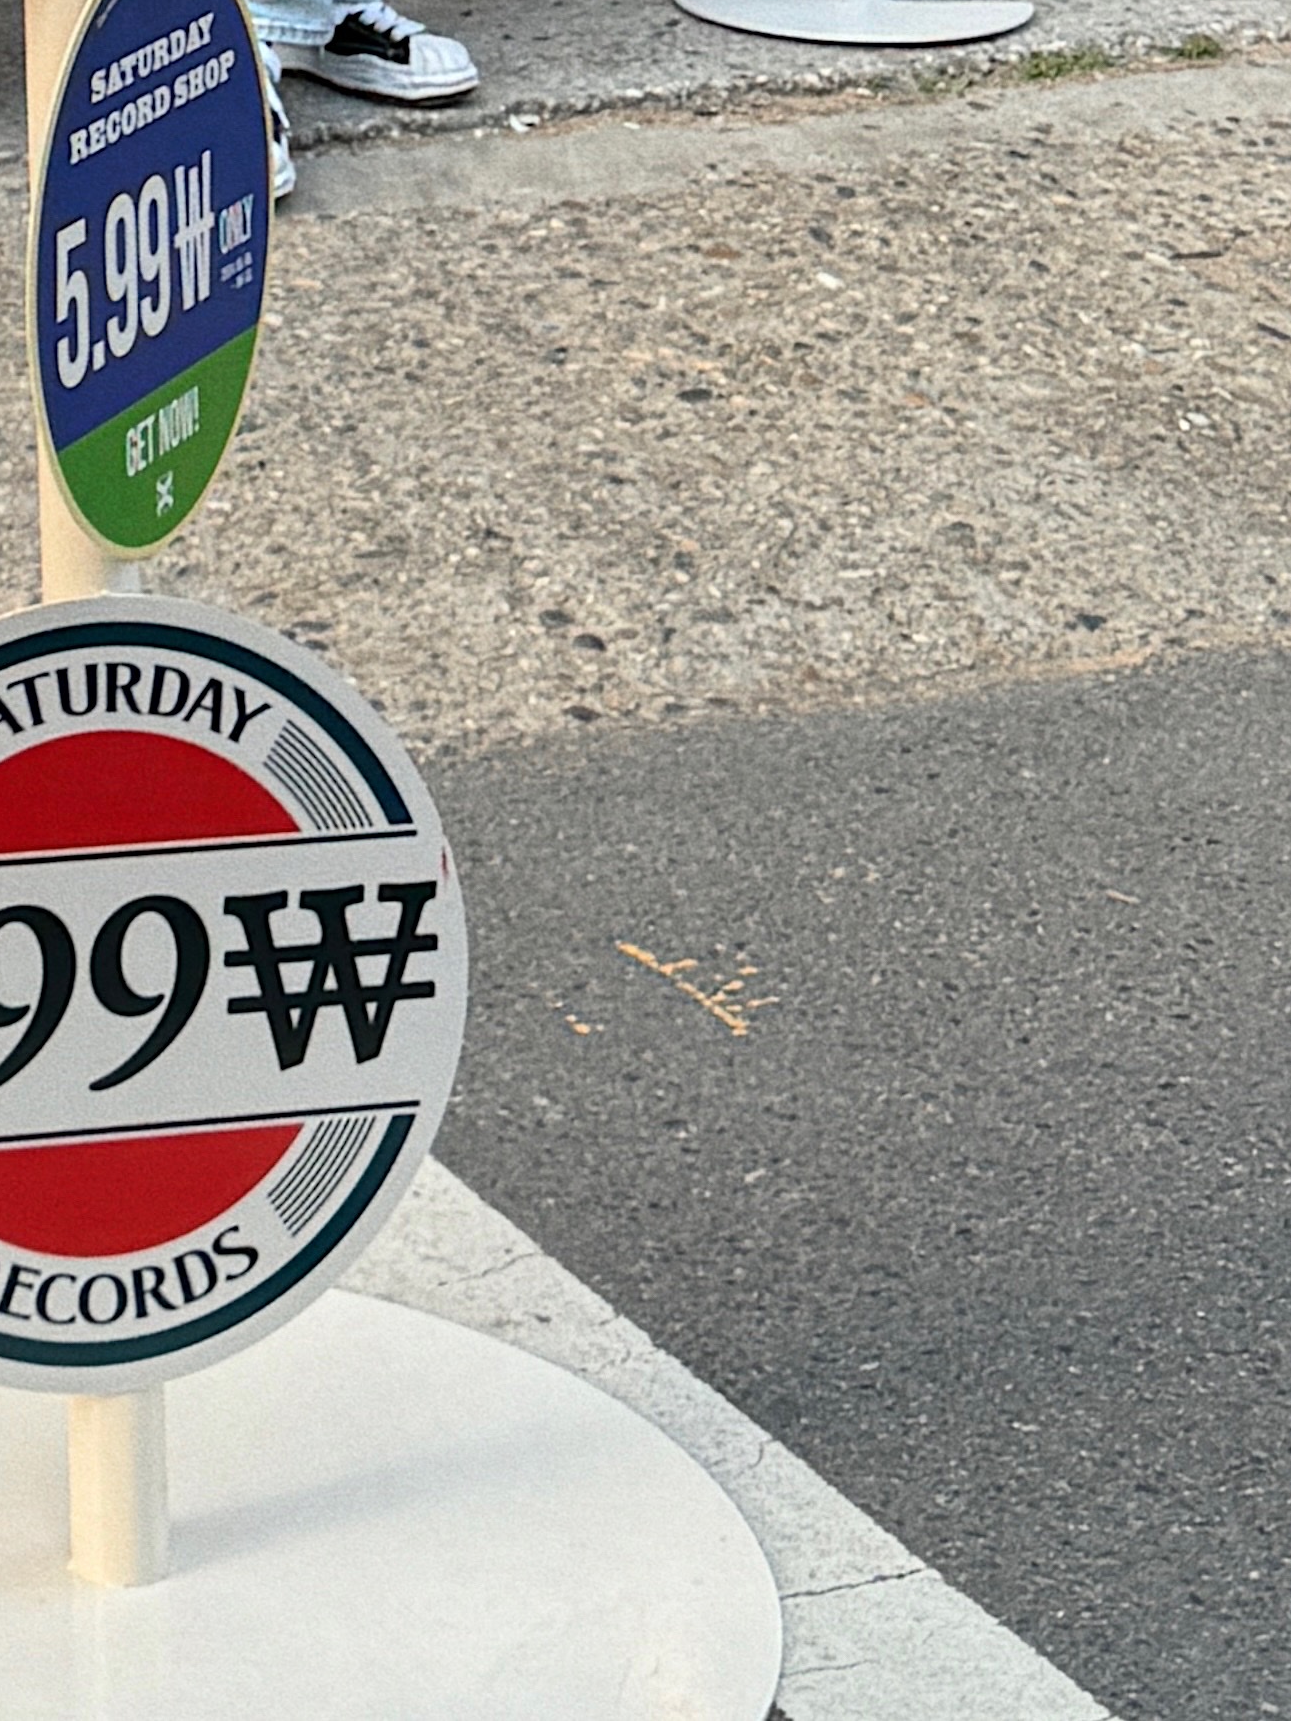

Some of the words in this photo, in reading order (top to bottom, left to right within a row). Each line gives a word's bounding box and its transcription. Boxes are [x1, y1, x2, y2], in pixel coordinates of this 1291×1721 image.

[91, 12, 215, 104] SATURDAY
[69, 85, 171, 165] RECORD
[173, 49, 235, 109] SHOP
[219, 193, 255, 255] ONLY
[125, 413, 156, 479] GET
[158, 385, 201, 457] NOW!
